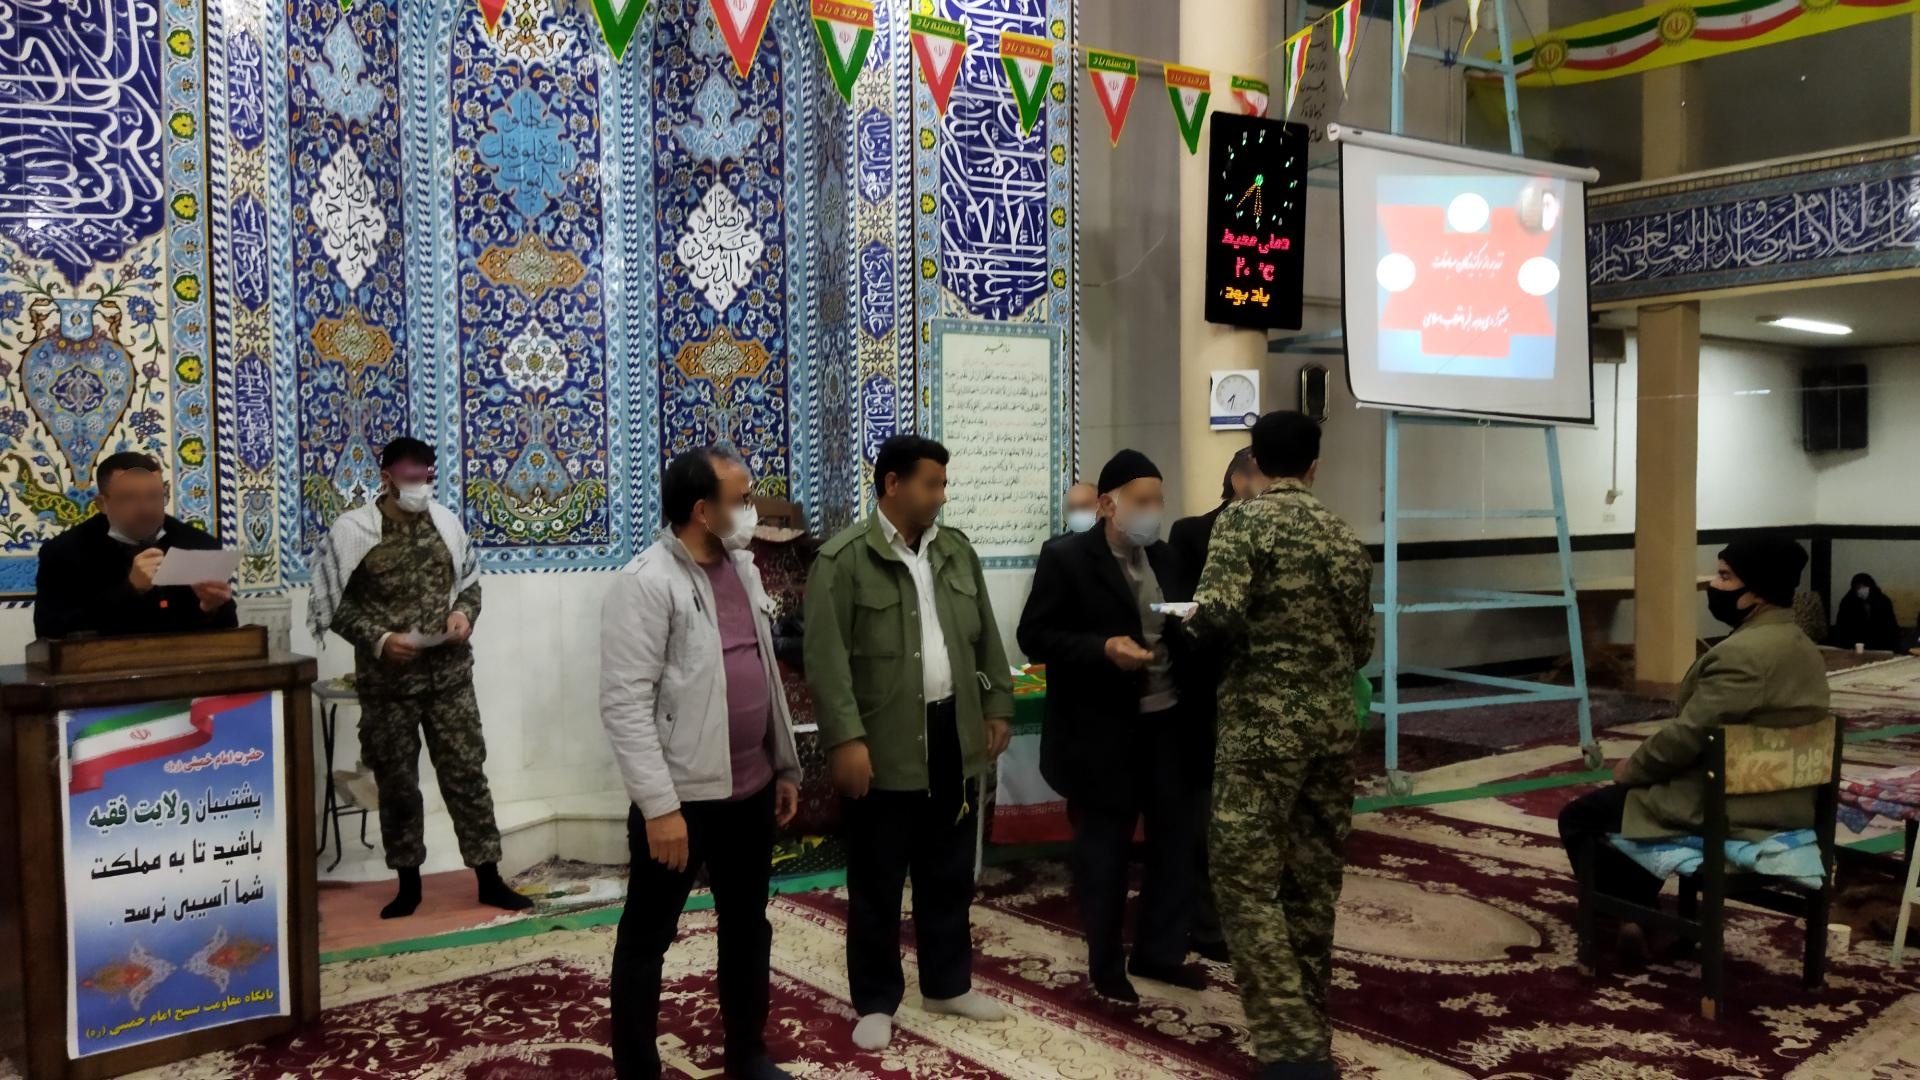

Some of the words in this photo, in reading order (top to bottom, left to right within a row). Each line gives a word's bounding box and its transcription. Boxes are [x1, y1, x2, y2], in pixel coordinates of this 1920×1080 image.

[916, 18, 929, 30] باد
[928, 20, 961, 36] خجسته
[1222, 228, 1258, 249] محیط
[1258, 233, 1290, 254] دمای
[214, 750, 234, 770] امام
[134, 790, 190, 827] ولایت
[196, 782, 261, 823] پشتیبان
[88, 795, 128, 834] فقیه
[193, 838, 205, 864] تا
[213, 830, 262, 866] باشید
[91, 848, 161, 880] مملکت
[169, 852, 185, 873] به
[235, 874, 263, 904] شما
[174, 879, 231, 921] آسیبی
[203, 995, 242, 1012] مقاومت
[244, 989, 274, 1003] پایگاه
[150, 1008, 172, 1025] امام
[175, 1005, 201, 1021] بسیج
[109, 1016, 146, 1036] خمینی
